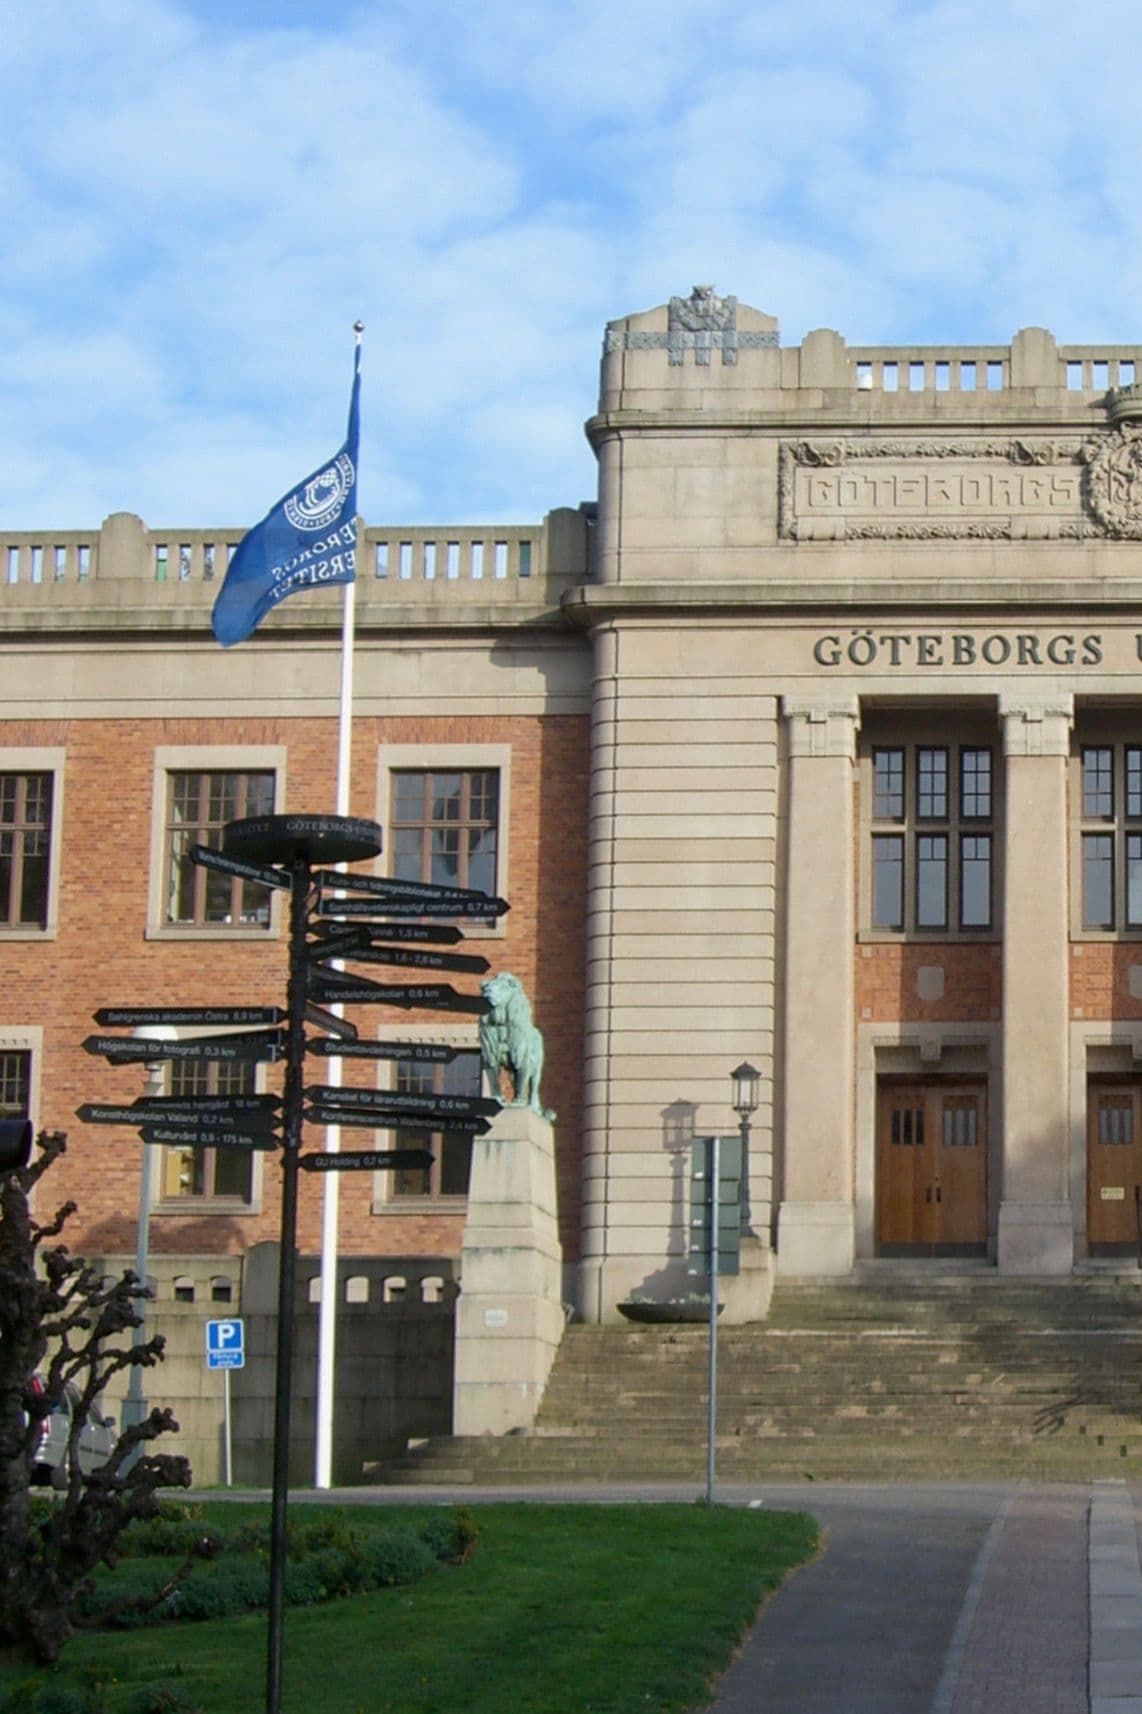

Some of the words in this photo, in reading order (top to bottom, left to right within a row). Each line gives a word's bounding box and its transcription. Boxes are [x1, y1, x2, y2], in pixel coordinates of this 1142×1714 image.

[813, 629, 1104, 667] GÖTEBORGS
[483, 902, 498, 911] km
[413, 929, 428, 938] km
[425, 989, 440, 998] km
[249, 1011, 264, 1020] km
[98, 1041, 146, 1054] Högskolan
[149, 1043, 162, 1052] för
[163, 1044, 200, 1056] fotografi
[221, 1047, 236, 1057] km
[432, 1048, 447, 1058] km
[246, 1099, 261, 1108] km
[360, 1093, 373, 1103] för
[455, 1102, 470, 1111] km
[91, 1109, 165, 1122] Konsthögskolan
[167, 1113, 198, 1124] Valand
[219, 1115, 235, 1125] km
[239, 1134, 253, 1144] km
[378, 1156, 392, 1166] km
[217, 1324, 236, 1348] P
